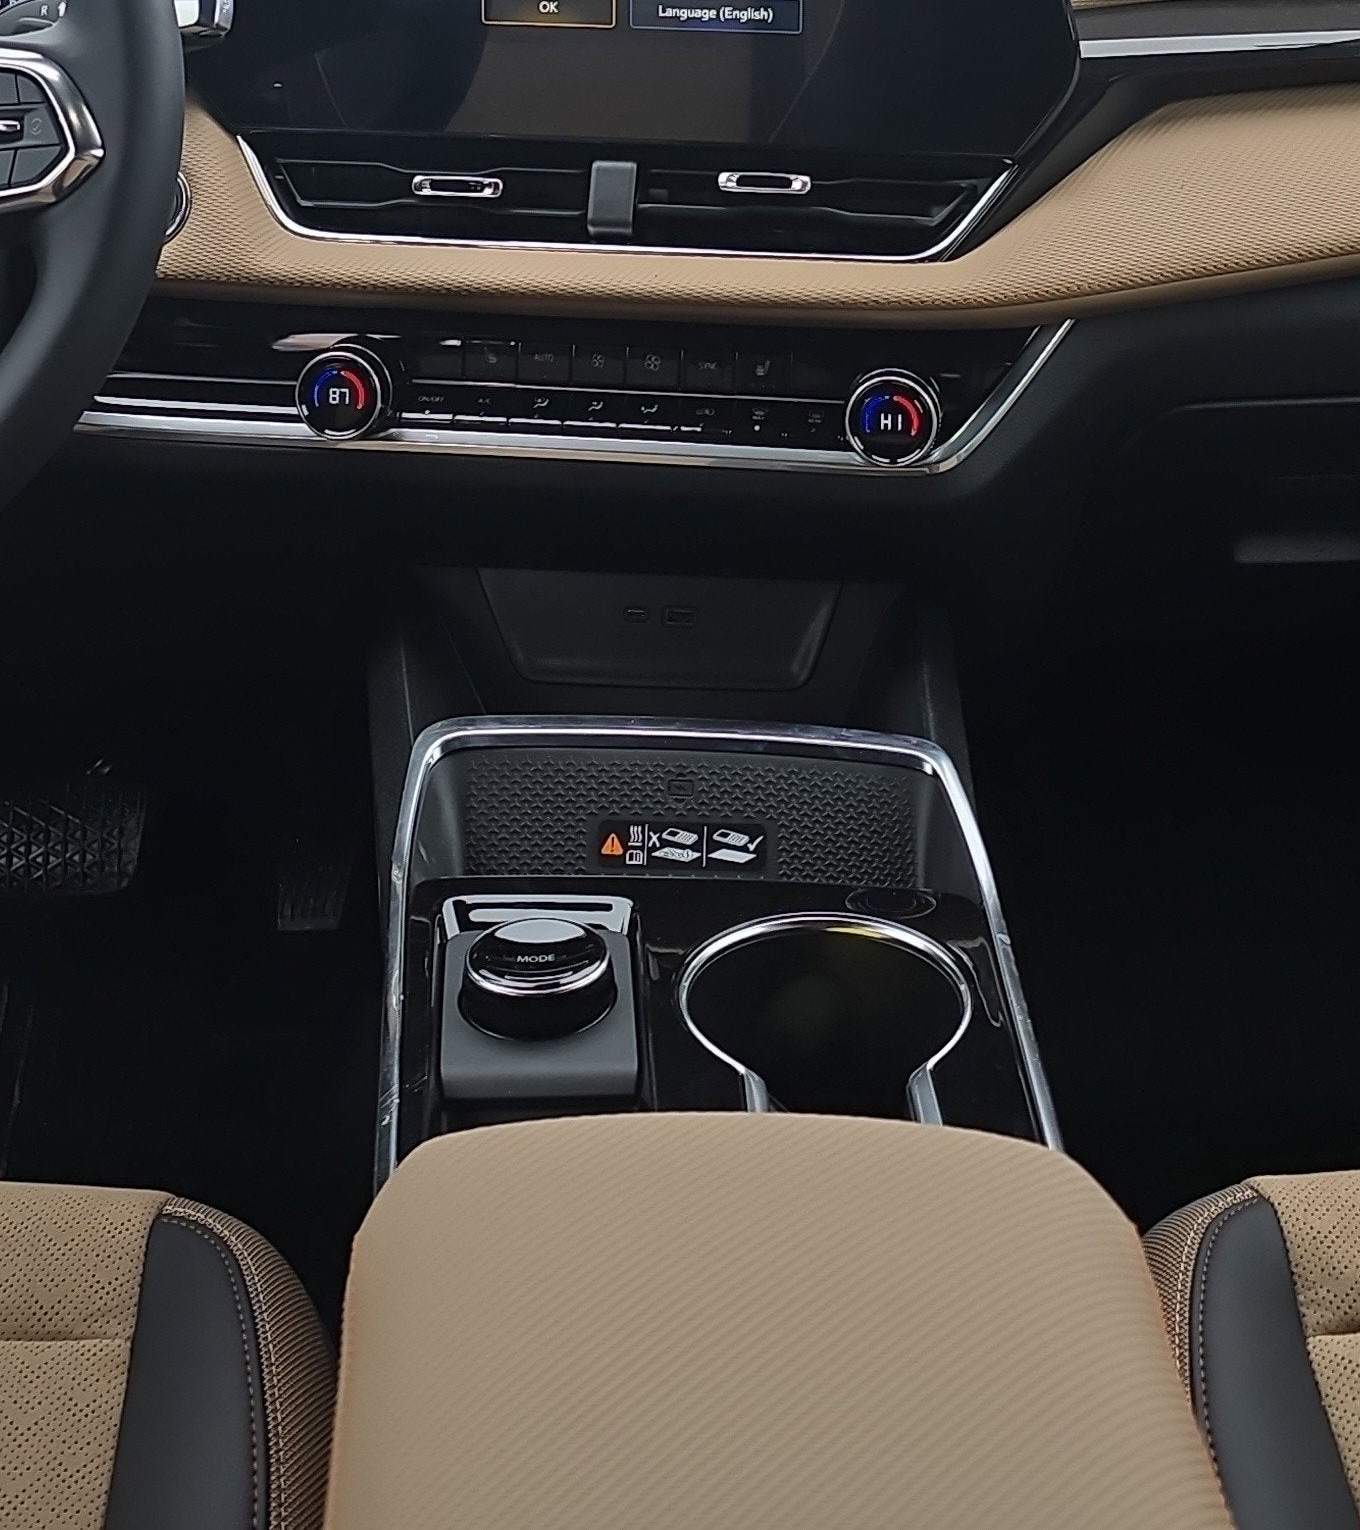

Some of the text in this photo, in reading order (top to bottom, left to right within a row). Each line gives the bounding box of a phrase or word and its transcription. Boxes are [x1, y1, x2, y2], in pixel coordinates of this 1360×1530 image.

[539, 0, 559, 13] OK
[658, 5, 774, 23] Language (English)
[534, 353, 554, 363] AUTO
[328, 387, 350, 405] 87
[880, 413, 903, 431] HI
[516, 952, 556, 964] MODE
